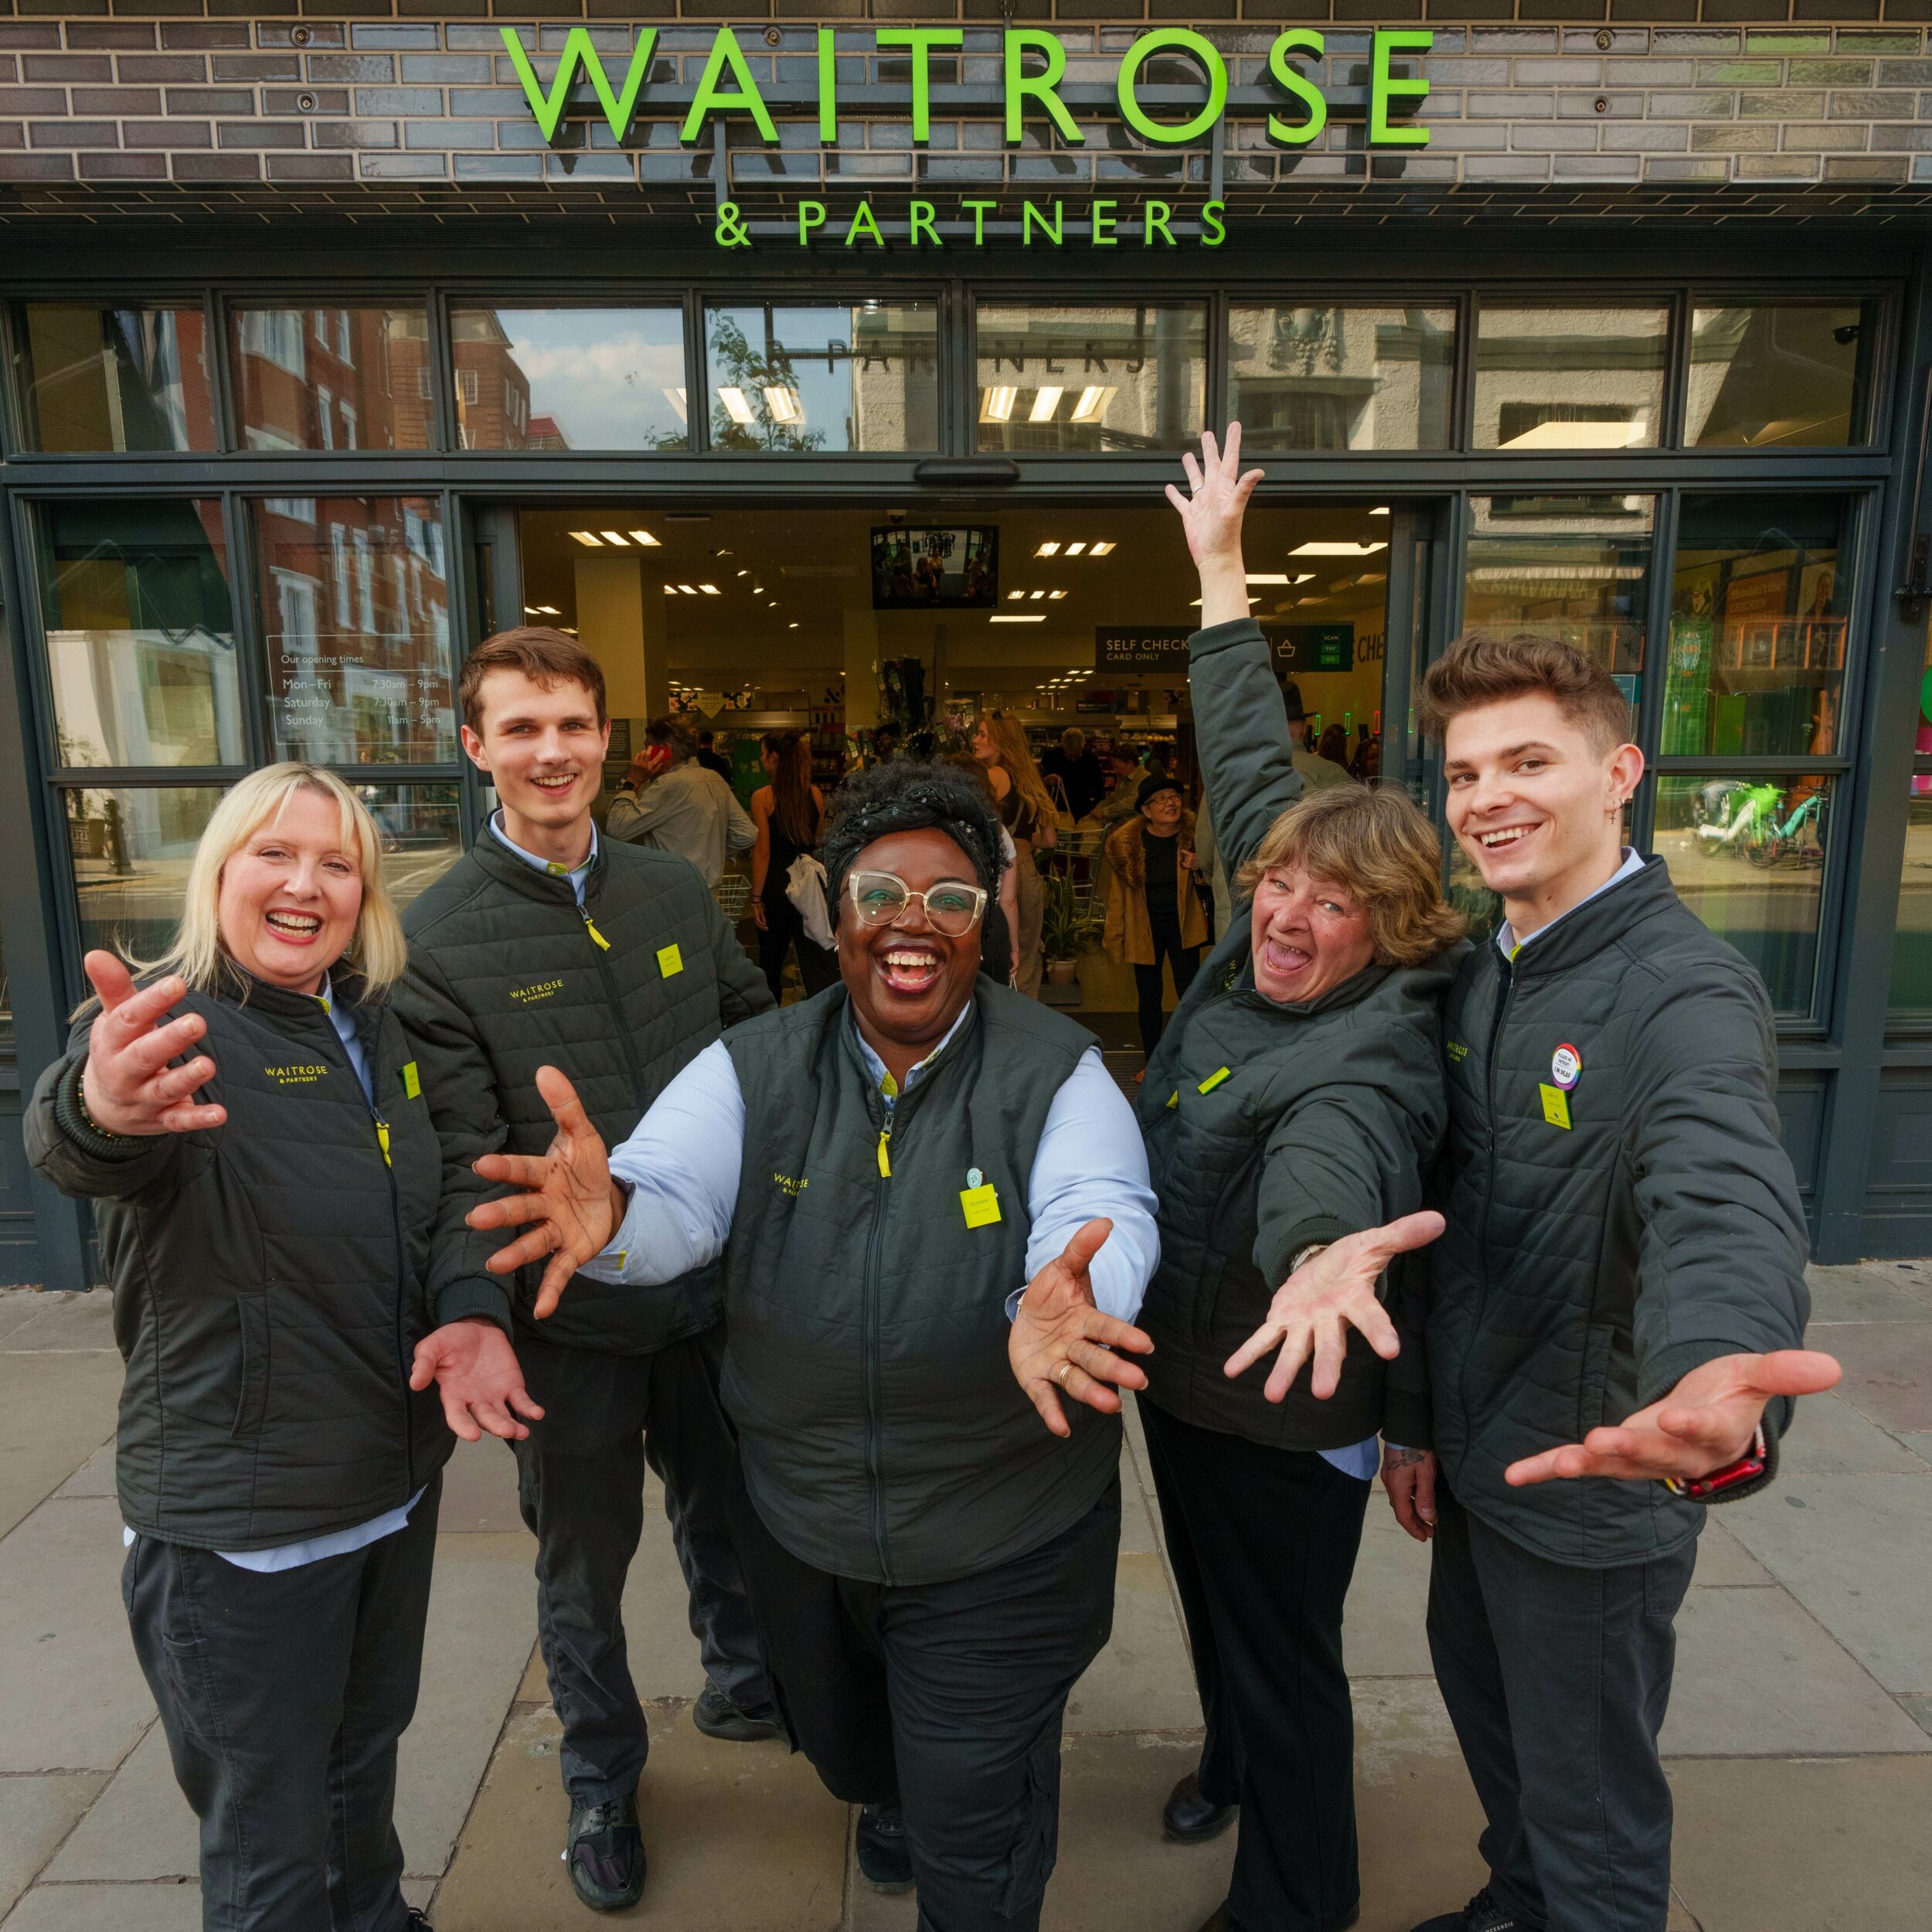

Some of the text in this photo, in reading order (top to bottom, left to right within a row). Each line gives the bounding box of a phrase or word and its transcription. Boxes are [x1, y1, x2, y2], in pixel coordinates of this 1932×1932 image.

[499, 28, 1434, 148] WAITROSE
[715, 200, 1226, 247] & PARTNERS
[1107, 640, 1137, 651] SELF
[281, 655, 364, 665] Our opening times
[372, 679, 406, 689] 7:30am
[417, 679, 438, 692] 9pm
[284, 696, 330, 709] Saturday
[374, 697, 407, 707] 7:30am
[419, 697, 440, 710] 9pm
[286, 715, 323, 728] Sunday
[387, 715, 408, 725] 11am
[420, 715, 440, 728] 5pm
[510, 979, 563, 998] WAITROSE
[528, 990, 554, 1002] PARTNERS
[264, 1066, 328, 1077] WAITROSE
[1560, 1070, 1571, 1079] DEAF
